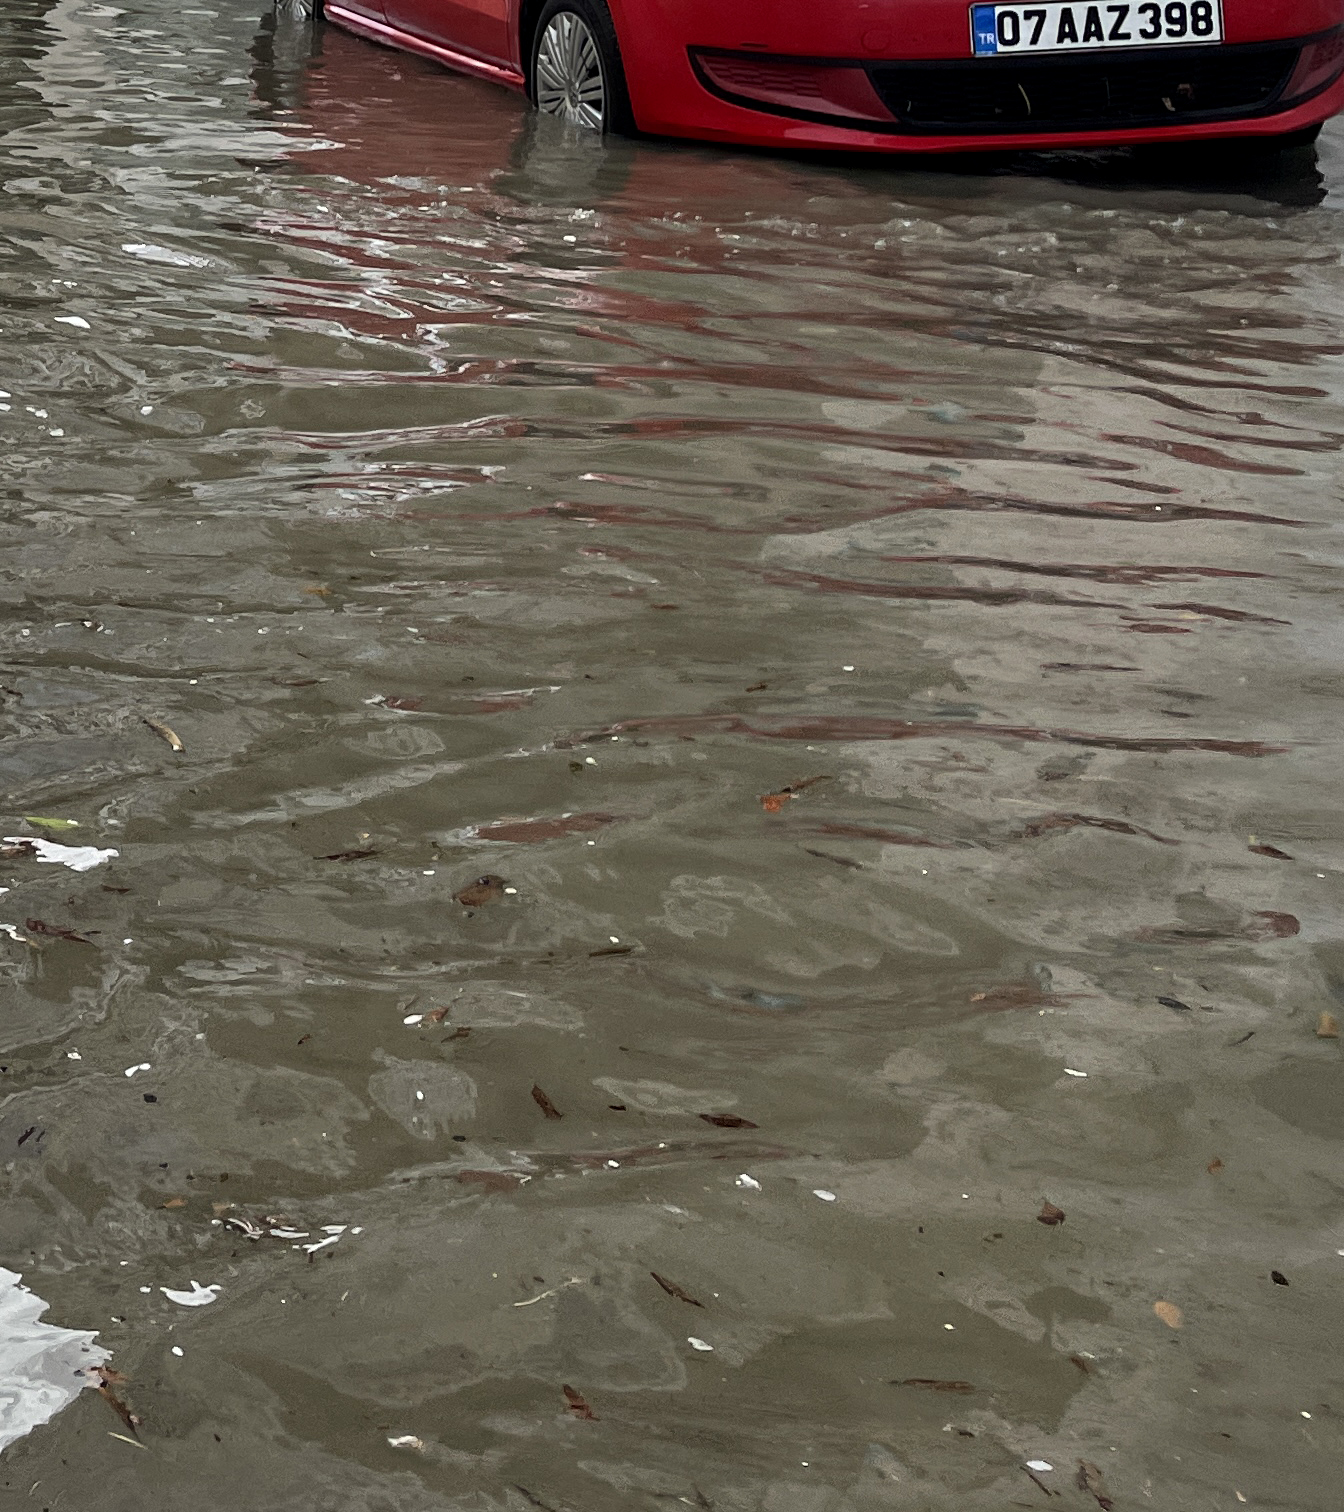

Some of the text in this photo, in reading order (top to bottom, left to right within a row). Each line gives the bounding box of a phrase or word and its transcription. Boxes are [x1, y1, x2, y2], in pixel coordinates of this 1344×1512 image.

[978, 0, 1214, 46] TR 07 AAZ 398
